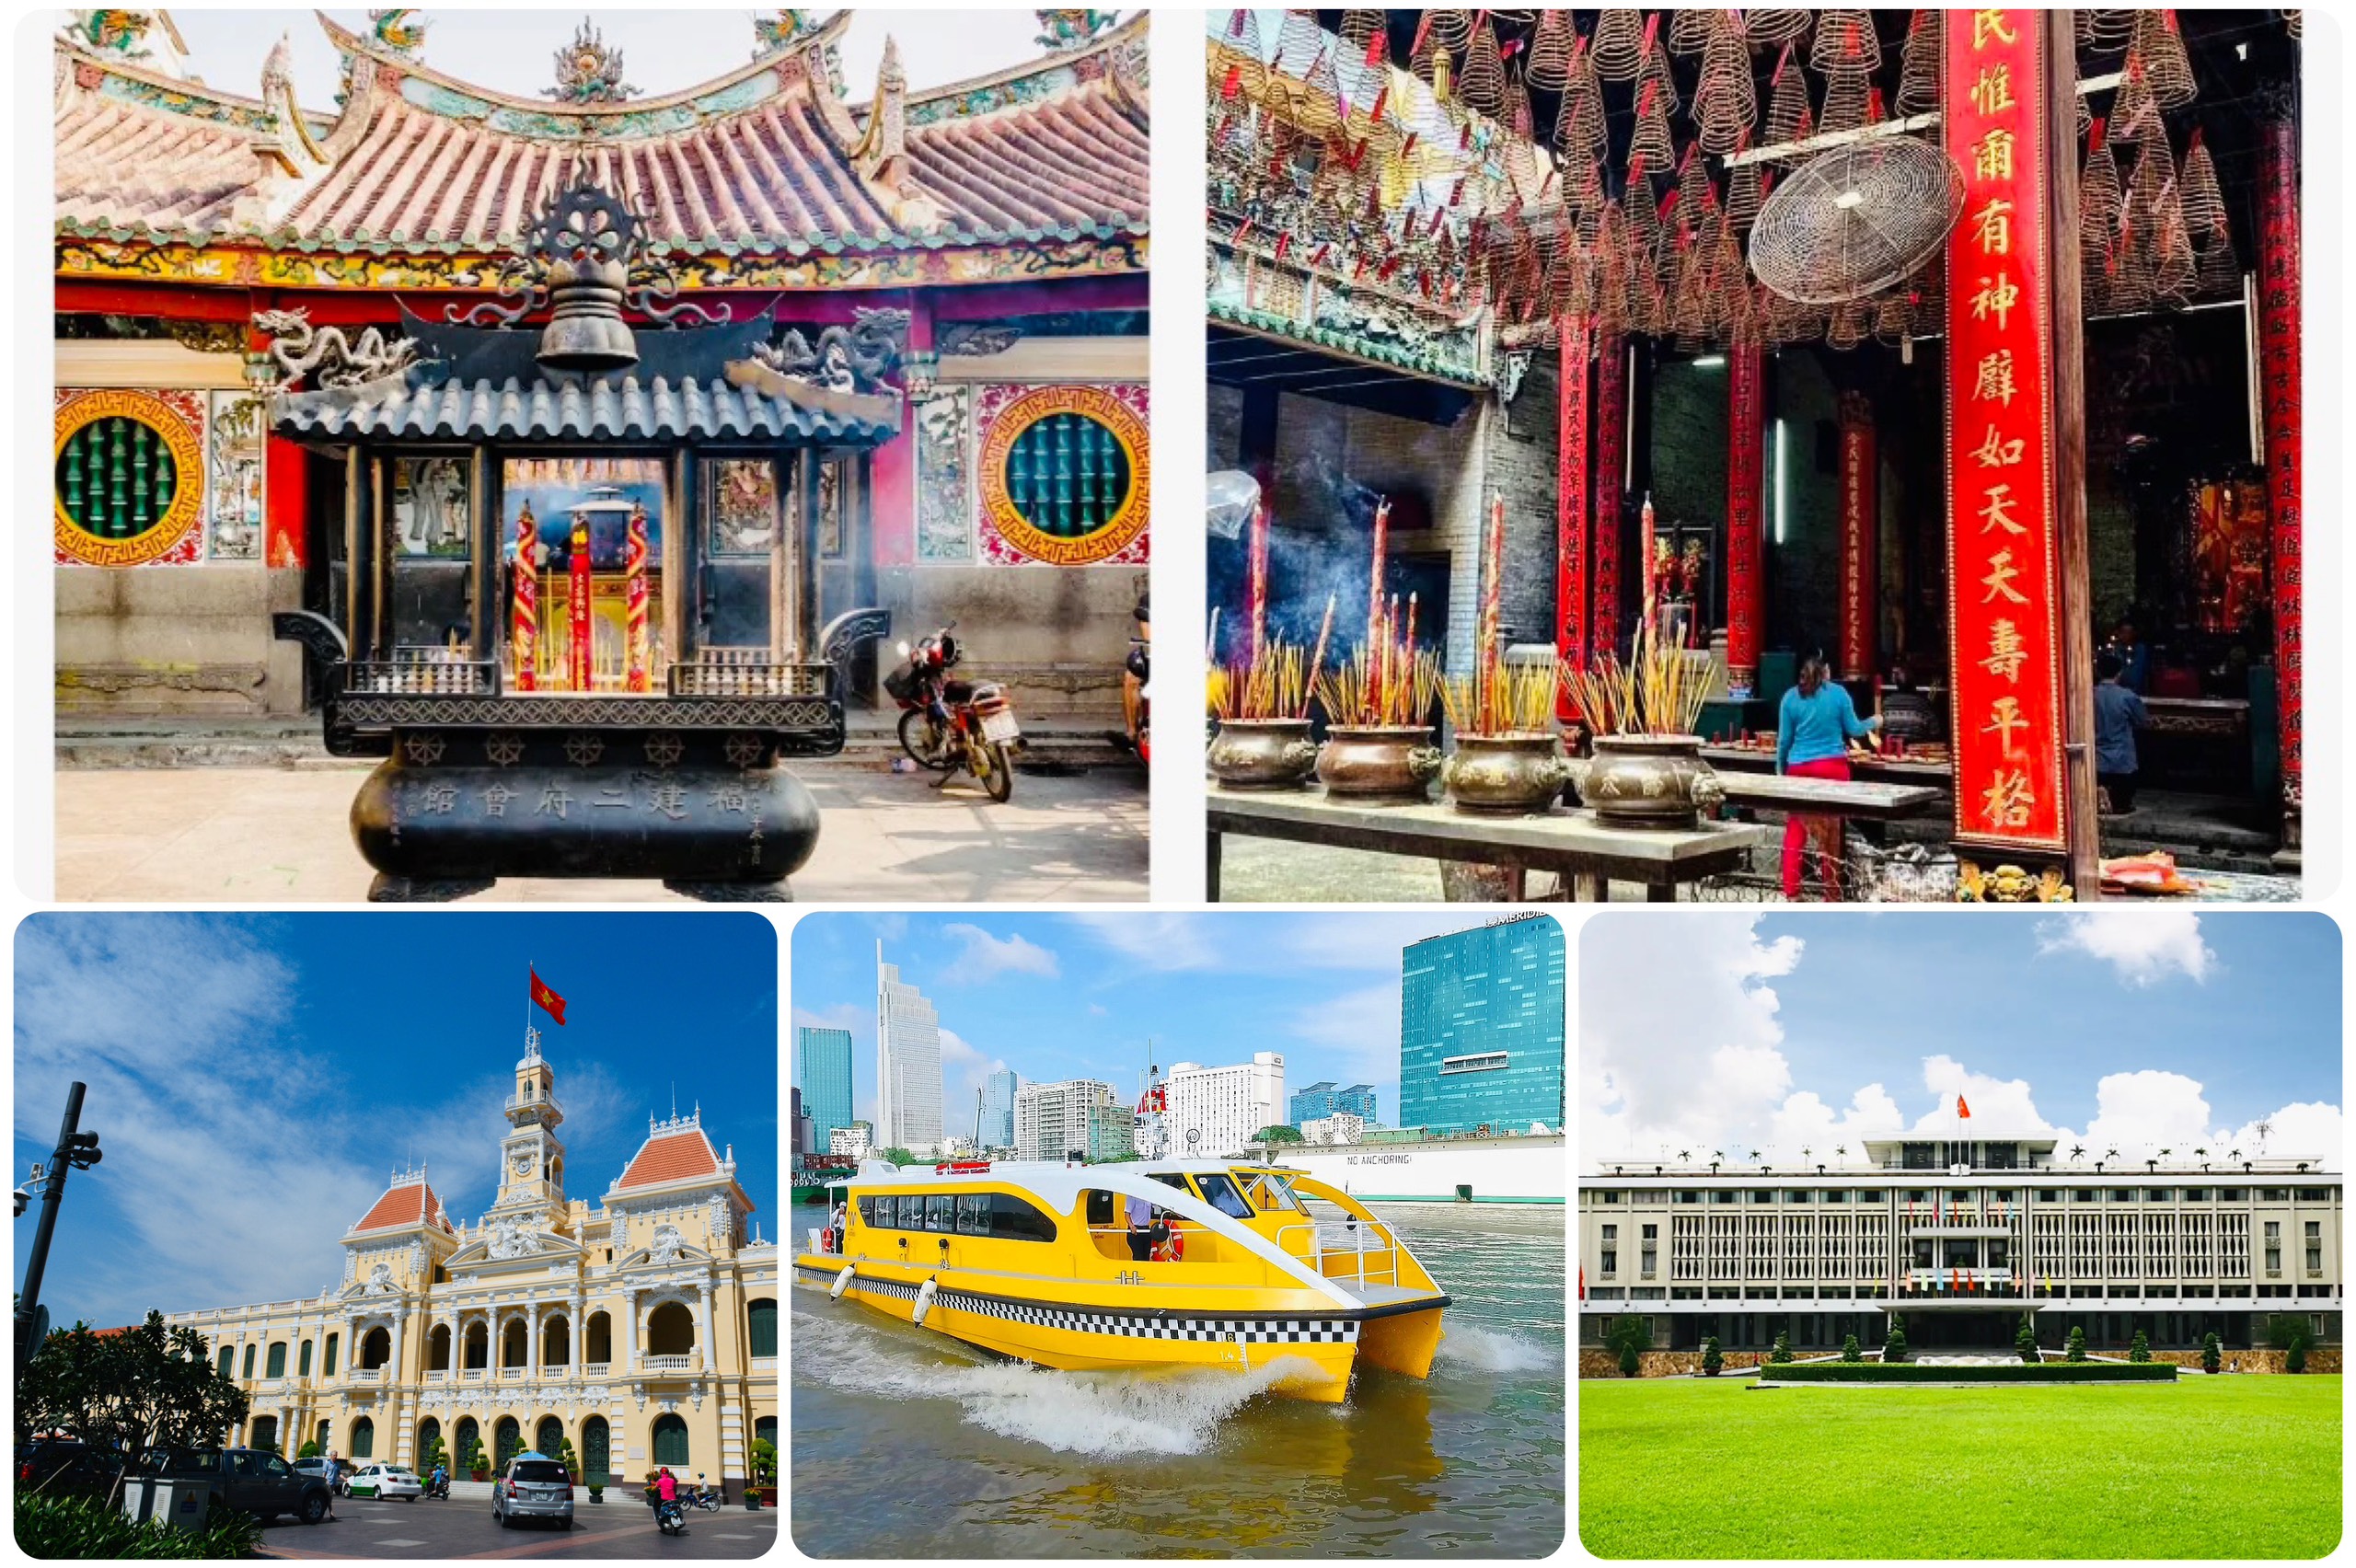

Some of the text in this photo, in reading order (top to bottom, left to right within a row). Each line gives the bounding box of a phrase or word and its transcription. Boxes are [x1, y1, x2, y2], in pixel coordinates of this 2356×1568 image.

[419, 779, 748, 821] 福建二府會館
[1347, 1156, 1358, 1165] NO
[1219, 1350, 1234, 1361] 1.4
